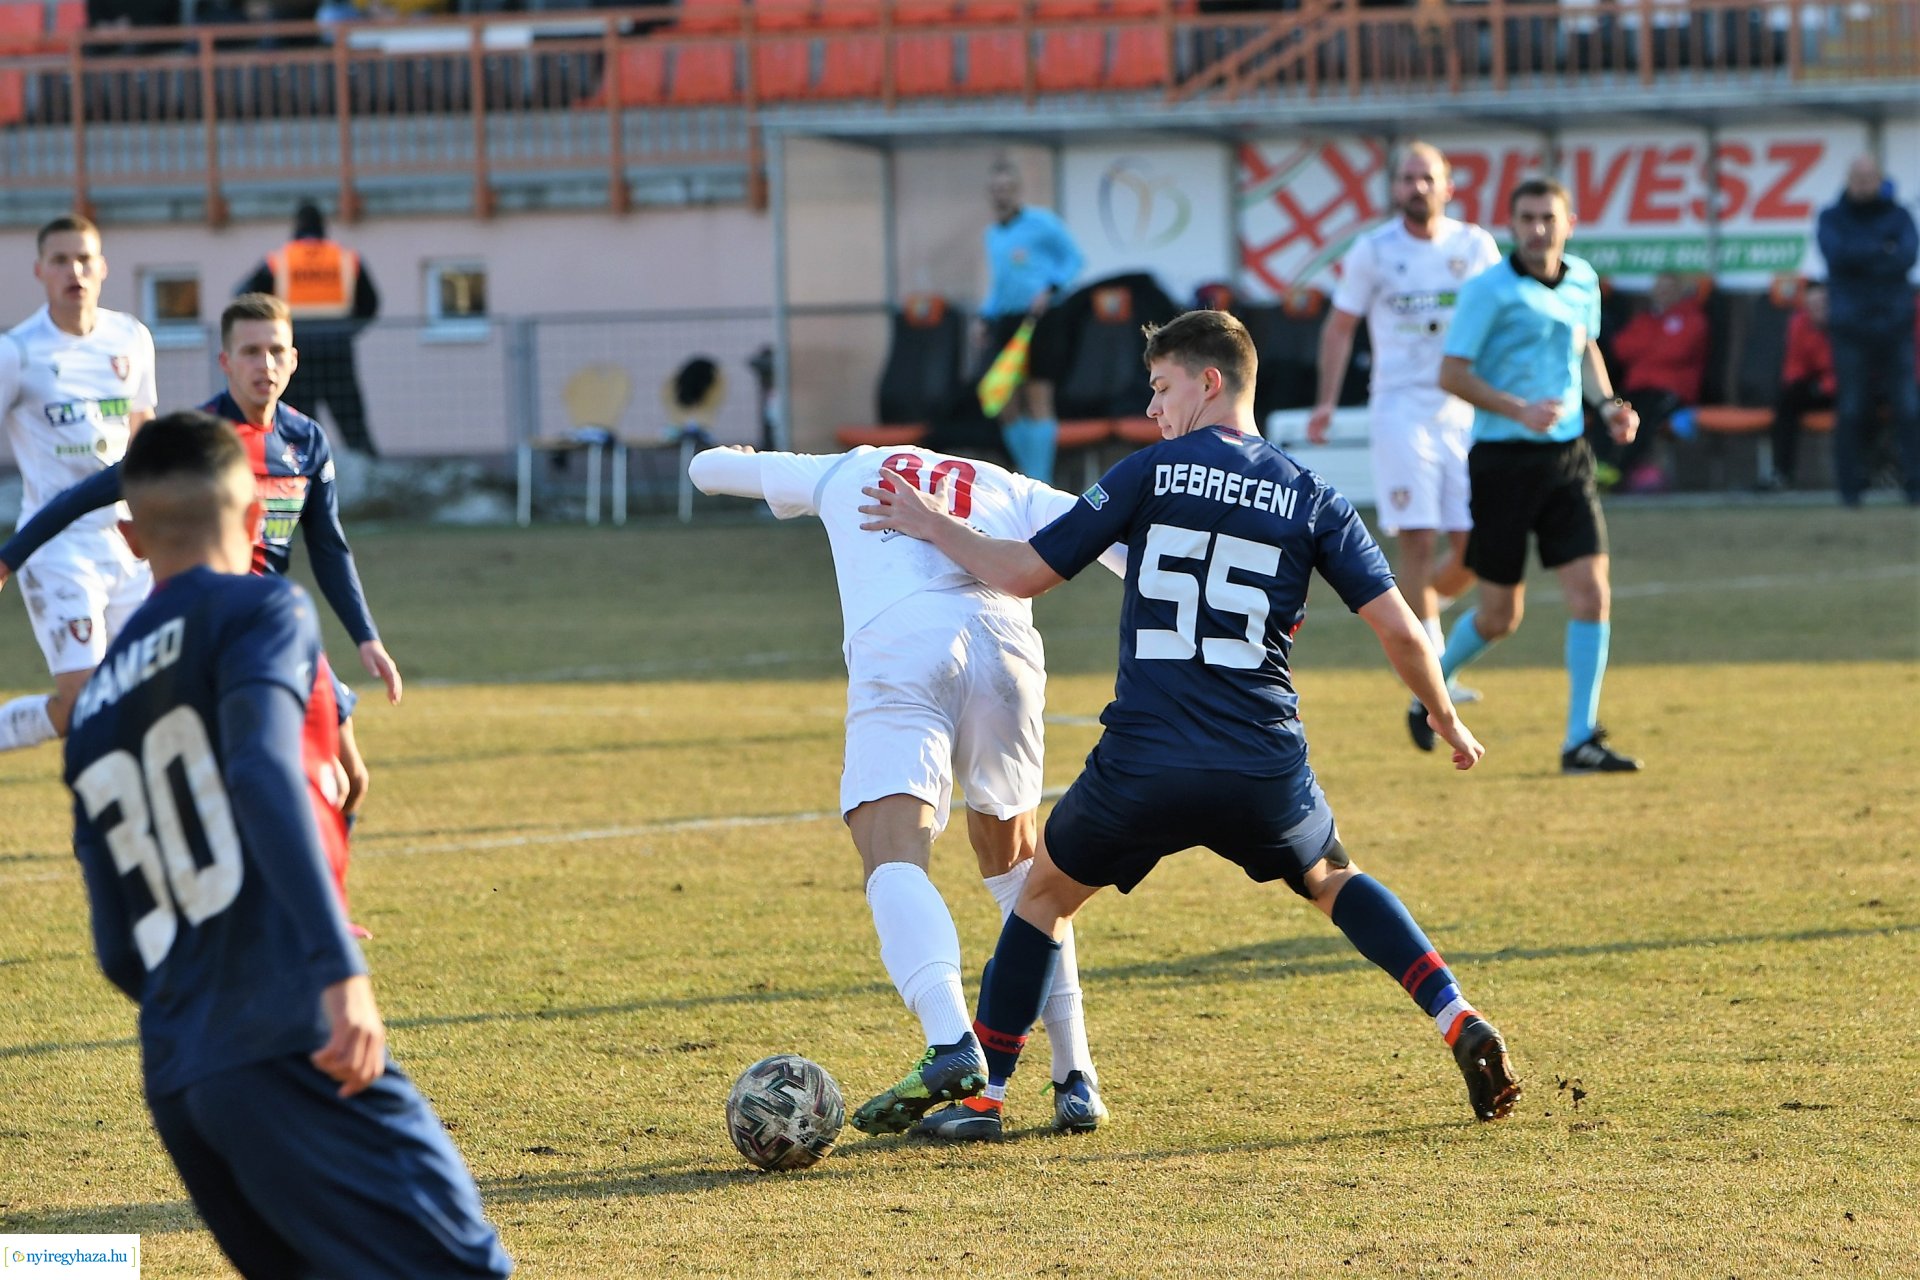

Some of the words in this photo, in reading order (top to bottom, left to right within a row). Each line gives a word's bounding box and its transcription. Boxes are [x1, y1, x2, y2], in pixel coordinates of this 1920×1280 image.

[1154, 463, 1298, 520] DEBRECENI
[1135, 523, 1283, 669] 55
[73, 703, 245, 972] 30
